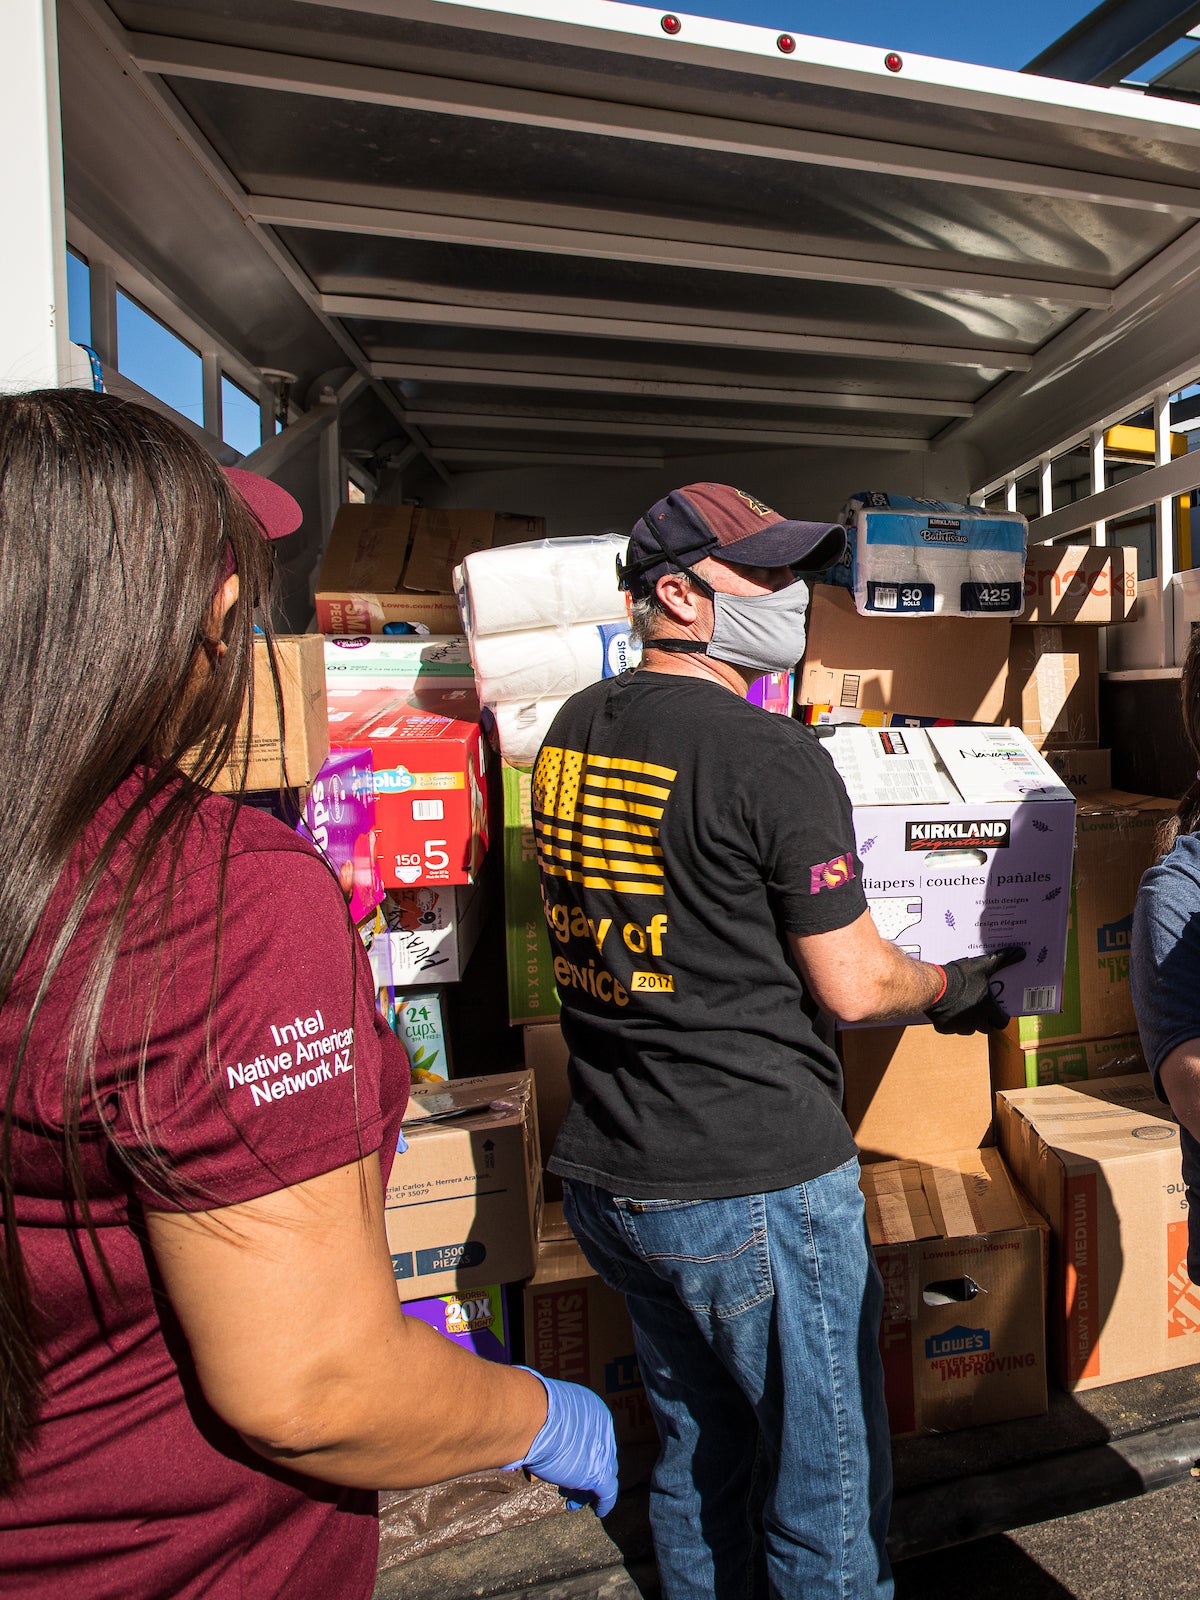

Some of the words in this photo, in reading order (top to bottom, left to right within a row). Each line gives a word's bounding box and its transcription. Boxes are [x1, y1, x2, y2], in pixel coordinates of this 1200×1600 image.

[930, 519, 960, 527] KIRKLAND
[921, 530, 944, 542] Bath
[1024, 566, 1124, 597] snack
[1126, 571, 1136, 597] BOX
[902, 589, 922, 601] 30
[979, 588, 1011, 602] 425
[911, 822, 1007, 839] KIRKLAND
[911, 837, 1001, 850] Signature
[395, 854, 421, 866] 150
[424, 839, 450, 870] 5
[926, 874, 986, 887] couches
[997, 872, 1051, 887] pañales
[419, 911, 436, 924] 6
[525, 922, 537, 939] 24
[622, 914, 668, 956] of
[527, 944, 538, 952] X
[527, 956, 538, 974] 18
[1098, 956, 1130, 968] NEVE
[528, 978, 538, 987] X
[638, 976, 671, 988] 2017
[529, 992, 539, 1009] 18
[406, 1005, 431, 1023] 24
[270, 1009, 325, 1047] Intel
[405, 1022, 438, 1039] cups
[227, 1052, 293, 1089] Native
[296, 1027, 354, 1065] American
[250, 1059, 333, 1107] Network
[334, 1048, 353, 1076] AZ
[402, 1181, 424, 1191] Carlos
[436, 1177, 462, 1185] Herrera
[396, 1191, 406, 1199] CP
[408, 1188, 429, 1197] 35079
[1075, 1192, 1087, 1266] MEDIUM
[437, 1246, 464, 1259] 1500
[923, 1241, 1021, 1261] Lowes.com/Moving
[433, 1254, 471, 1270] PIEZAS
[449, 1290, 488, 1303] ABSORBS
[1076, 1270, 1088, 1313] DUTY
[447, 1298, 492, 1325] 20X
[447, 1324, 461, 1333] ITS
[462, 1319, 493, 1331] WEIGHT
[536, 1297, 557, 1369] PEQUEÑA
[932, 1334, 984, 1354] LOWE'S
[1078, 1314, 1089, 1362] HEAVY
[931, 1355, 966, 1370] NEVER
[968, 1351, 996, 1364] STOP
[941, 1353, 1036, 1381] IMPROVING
